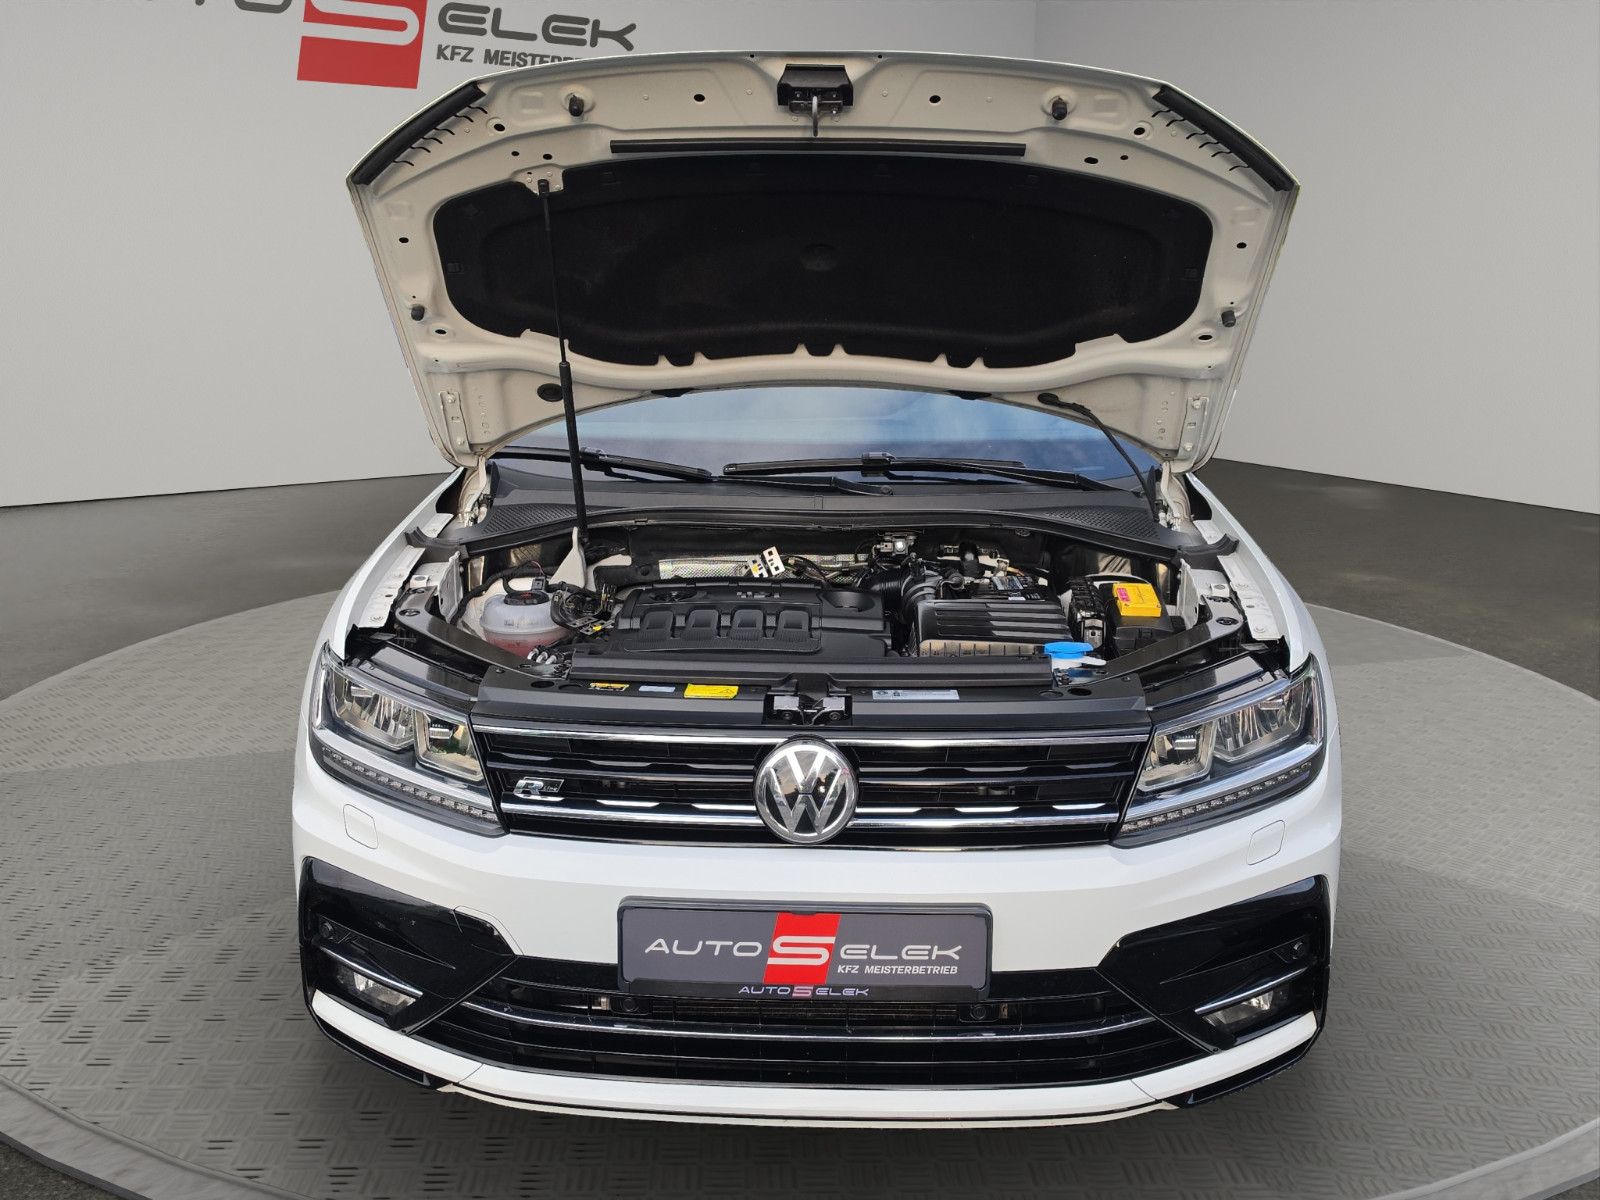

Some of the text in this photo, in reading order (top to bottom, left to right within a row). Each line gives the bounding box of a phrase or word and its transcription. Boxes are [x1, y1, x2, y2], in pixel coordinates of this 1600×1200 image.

[436, 44, 475, 63] KFZ
[644, 938, 763, 957] AUTO
[837, 965, 958, 975] KFZ MEISTERBETRIEB
[738, 986, 791, 996] AUTO
